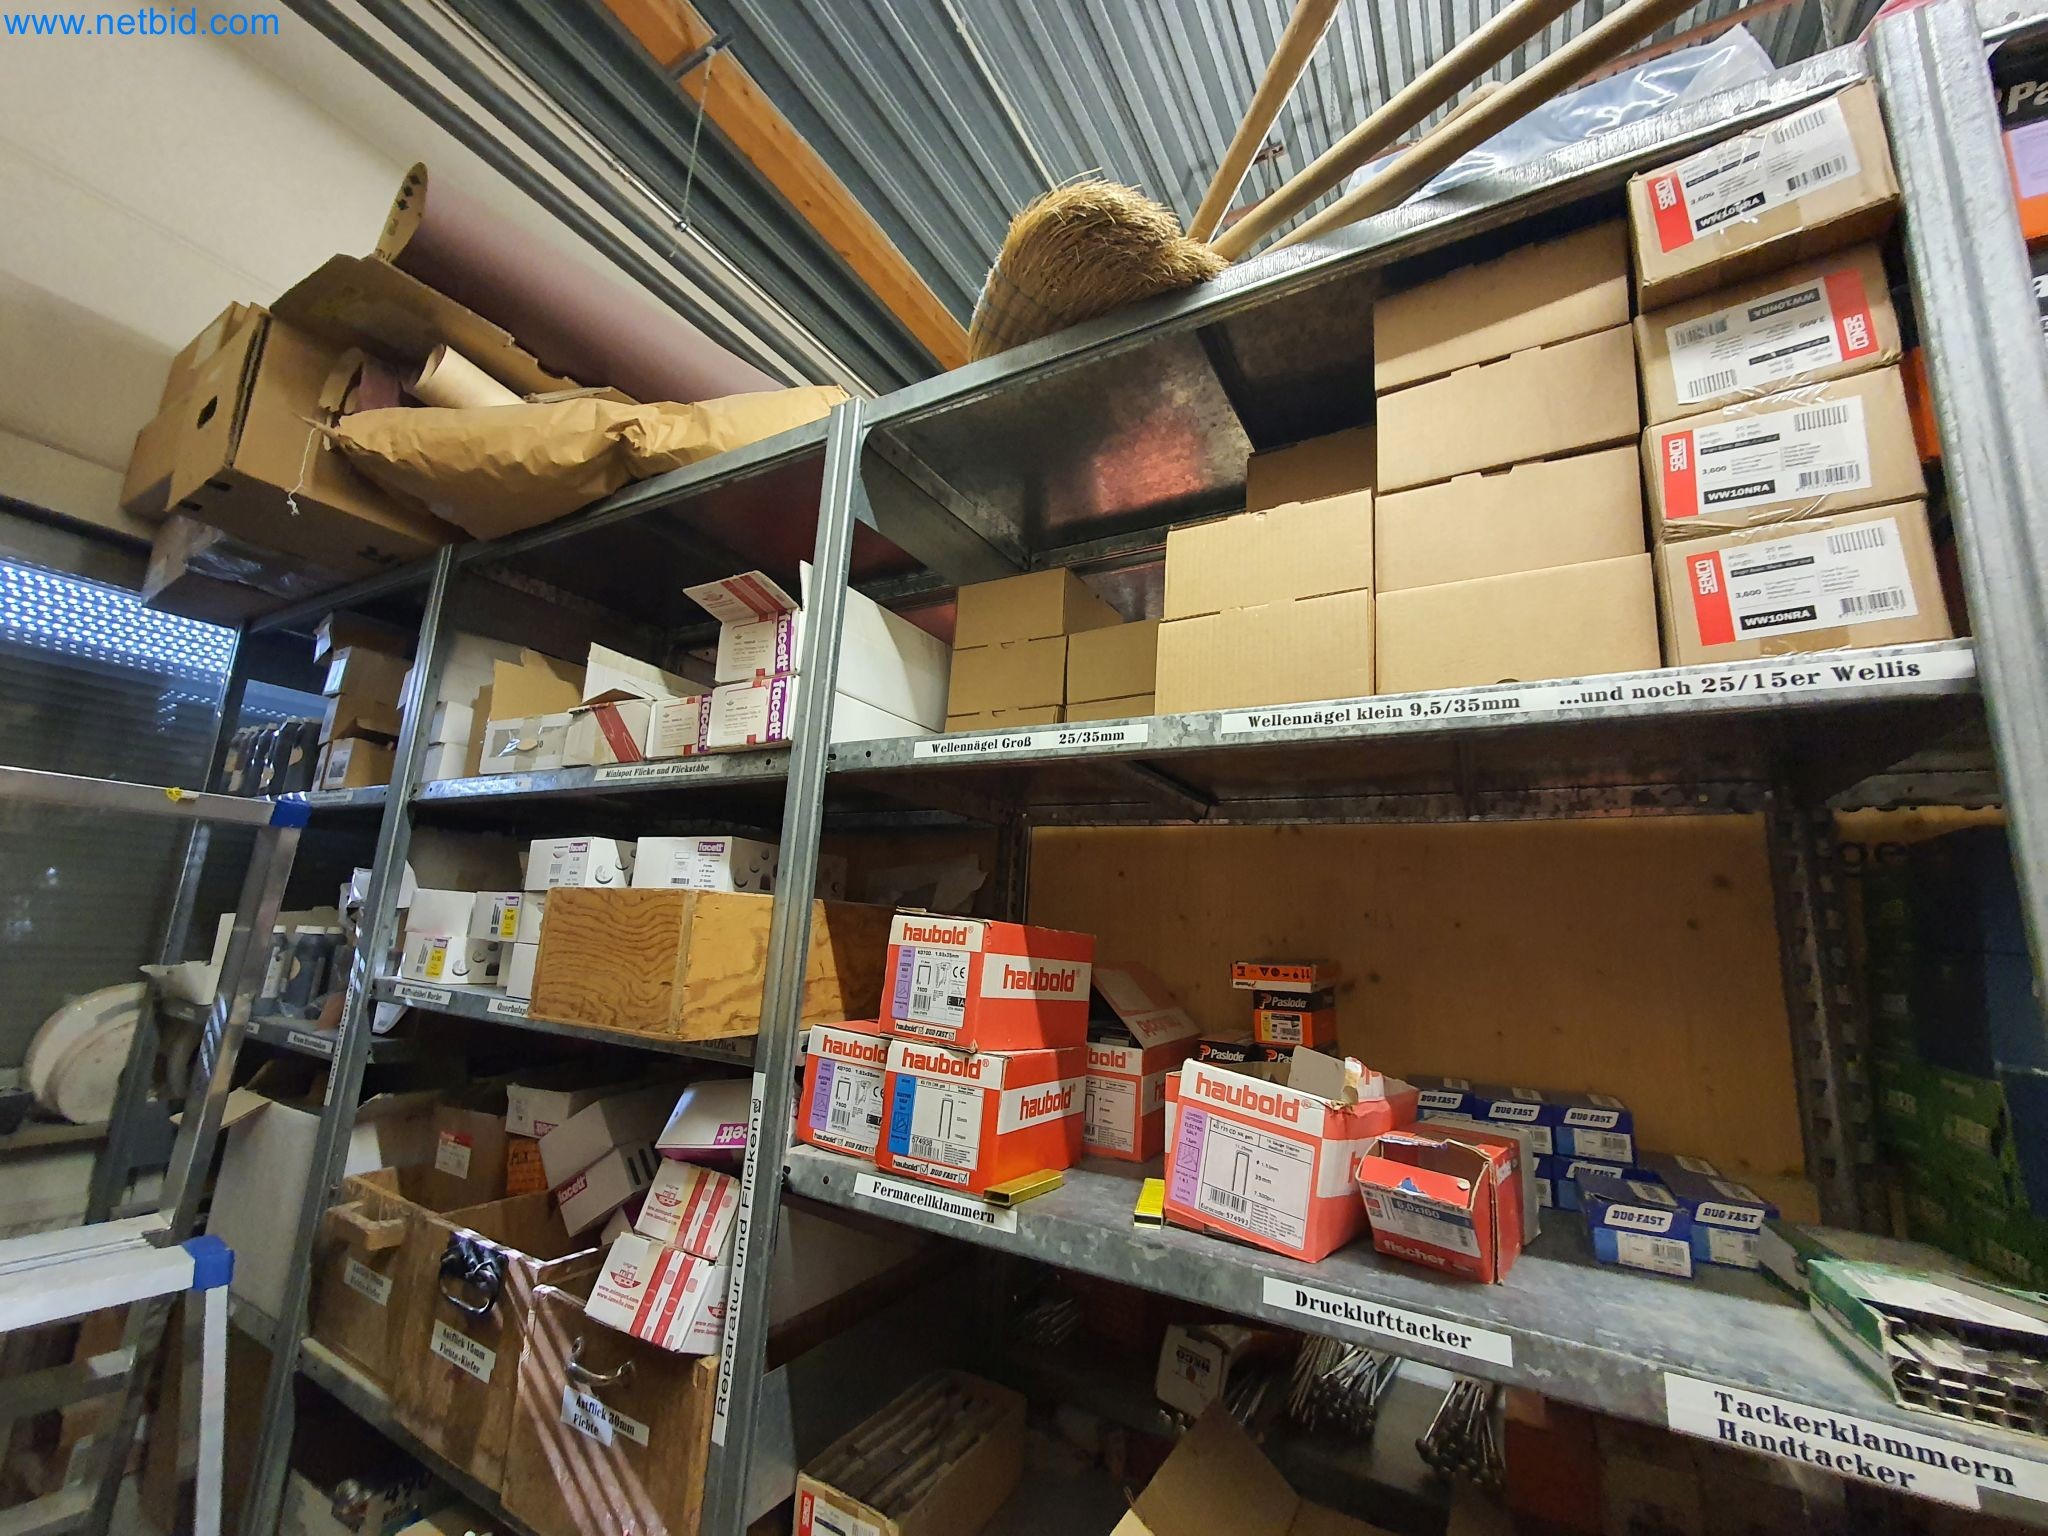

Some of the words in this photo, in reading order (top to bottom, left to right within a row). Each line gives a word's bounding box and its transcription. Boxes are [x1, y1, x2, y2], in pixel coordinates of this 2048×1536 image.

[1843, 313, 1869, 351] SENCO
[1669, 437, 1687, 472] SENCO
[1708, 484, 1770, 502] WW10NRA
[1695, 558, 1718, 596] SENCO
[1744, 608, 1811, 628] WW10NRA
[1631, 680, 1692, 700] noch
[1701, 670, 1822, 694] 25/15er
[1830, 658, 1922, 683] Wellis
[769, 679, 785, 740] facett
[1248, 708, 1351, 728] Wellennägel
[1356, 705, 1403, 721] klein
[1409, 697, 1521, 717] 9,5/35mm
[931, 738, 998, 754] Wellennägel
[1001, 737, 1033, 749] Groß
[1058, 731, 1126, 745] 25/35mm
[903, 923, 968, 945] haubold
[1003, 964, 1076, 992] haubold
[1271, 996, 1308, 1009] Paslode
[902, 1047, 982, 1080] haubold
[1088, 1050, 1127, 1069] bold
[1210, 1047, 1245, 1062] Paslode
[1019, 1085, 1072, 1121] haubold
[1195, 1071, 1300, 1123] haubold
[741, 1117, 759, 1210] Flicken
[892, 1159, 919, 1172] haubold
[872, 1180, 996, 1225] Fermacellklammern
[736, 1218, 748, 1269] und
[1383, 1239, 1447, 1266] fischer
[618, 1268, 637, 1280] mini
[1294, 1288, 1473, 1352] Drucklufttacker
[716, 1281, 741, 1418] Reparatur
[572, 1412, 600, 1436] Fichte
[575, 1394, 607, 1421] Astflick
[608, 1410, 635, 1437] 30mm
[1713, 1389, 2016, 1487] Tackerklammern
[1717, 1417, 1918, 1490] Handtacker
